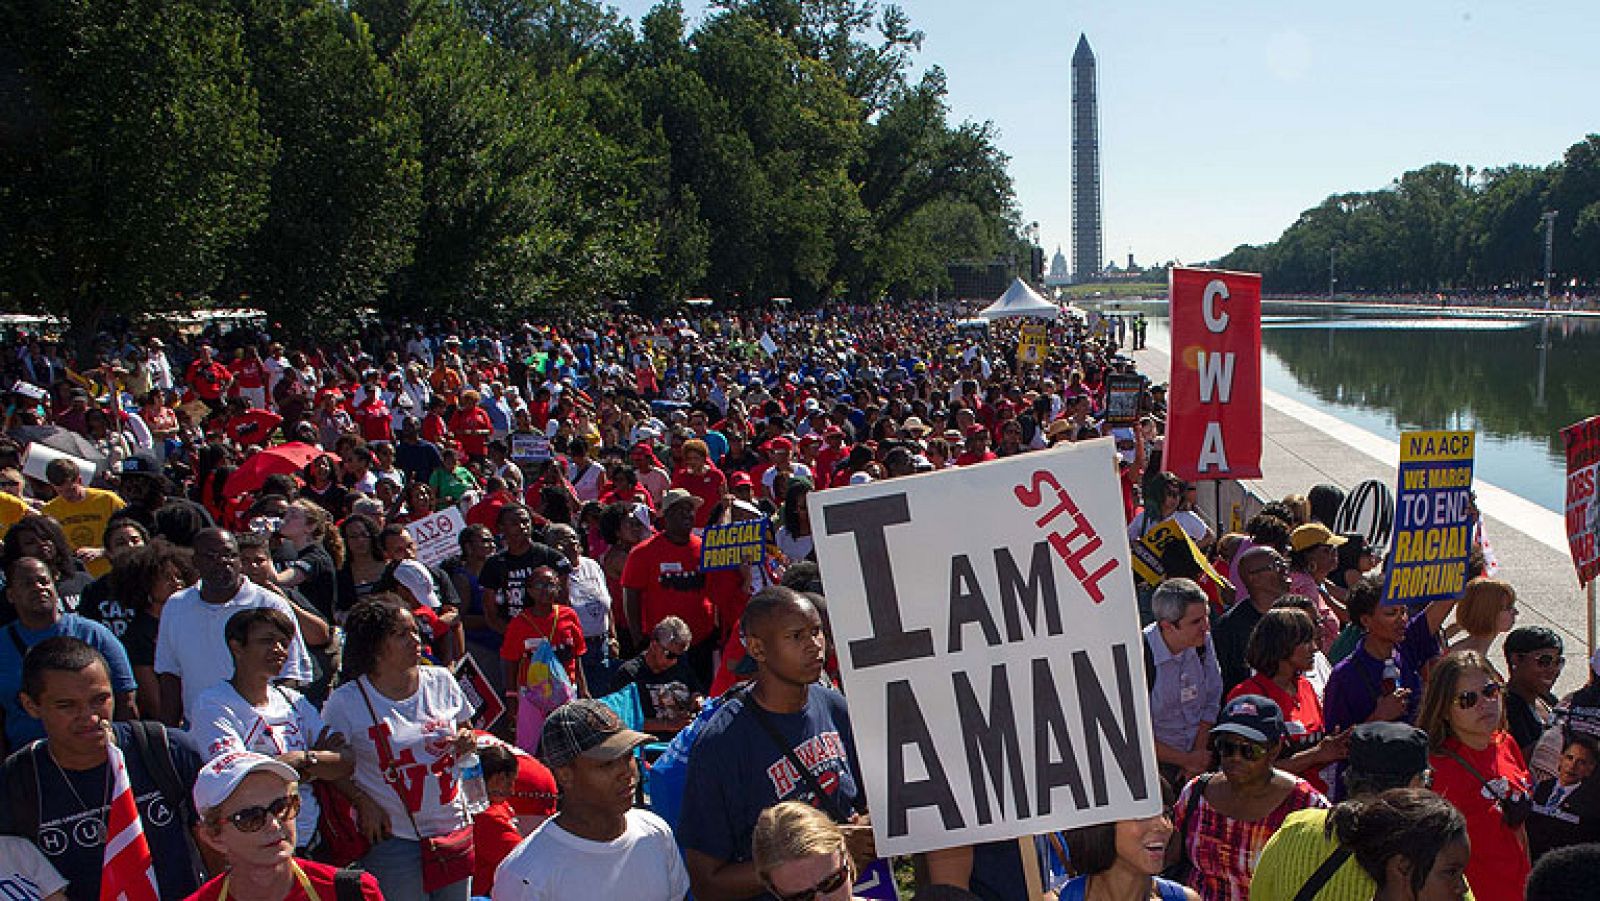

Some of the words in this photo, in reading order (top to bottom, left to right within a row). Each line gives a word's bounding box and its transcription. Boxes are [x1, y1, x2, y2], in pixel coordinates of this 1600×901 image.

[1197, 278, 1236, 473] CWA
[1409, 435, 1470, 456] NAACP
[1404, 469, 1426, 490] WE
[1428, 467, 1471, 489] MARCH
[1402, 494, 1428, 527] TO
[1433, 491, 1470, 525] END
[705, 523, 762, 547] RACIAL
[1013, 470, 1120, 604] STILL
[1395, 525, 1468, 562] RACIAL
[822, 491, 935, 669] I
[947, 541, 1064, 654] AM
[1387, 560, 1466, 600] PROFILING
[886, 679, 967, 838] A
[951, 644, 1149, 826] MAN
